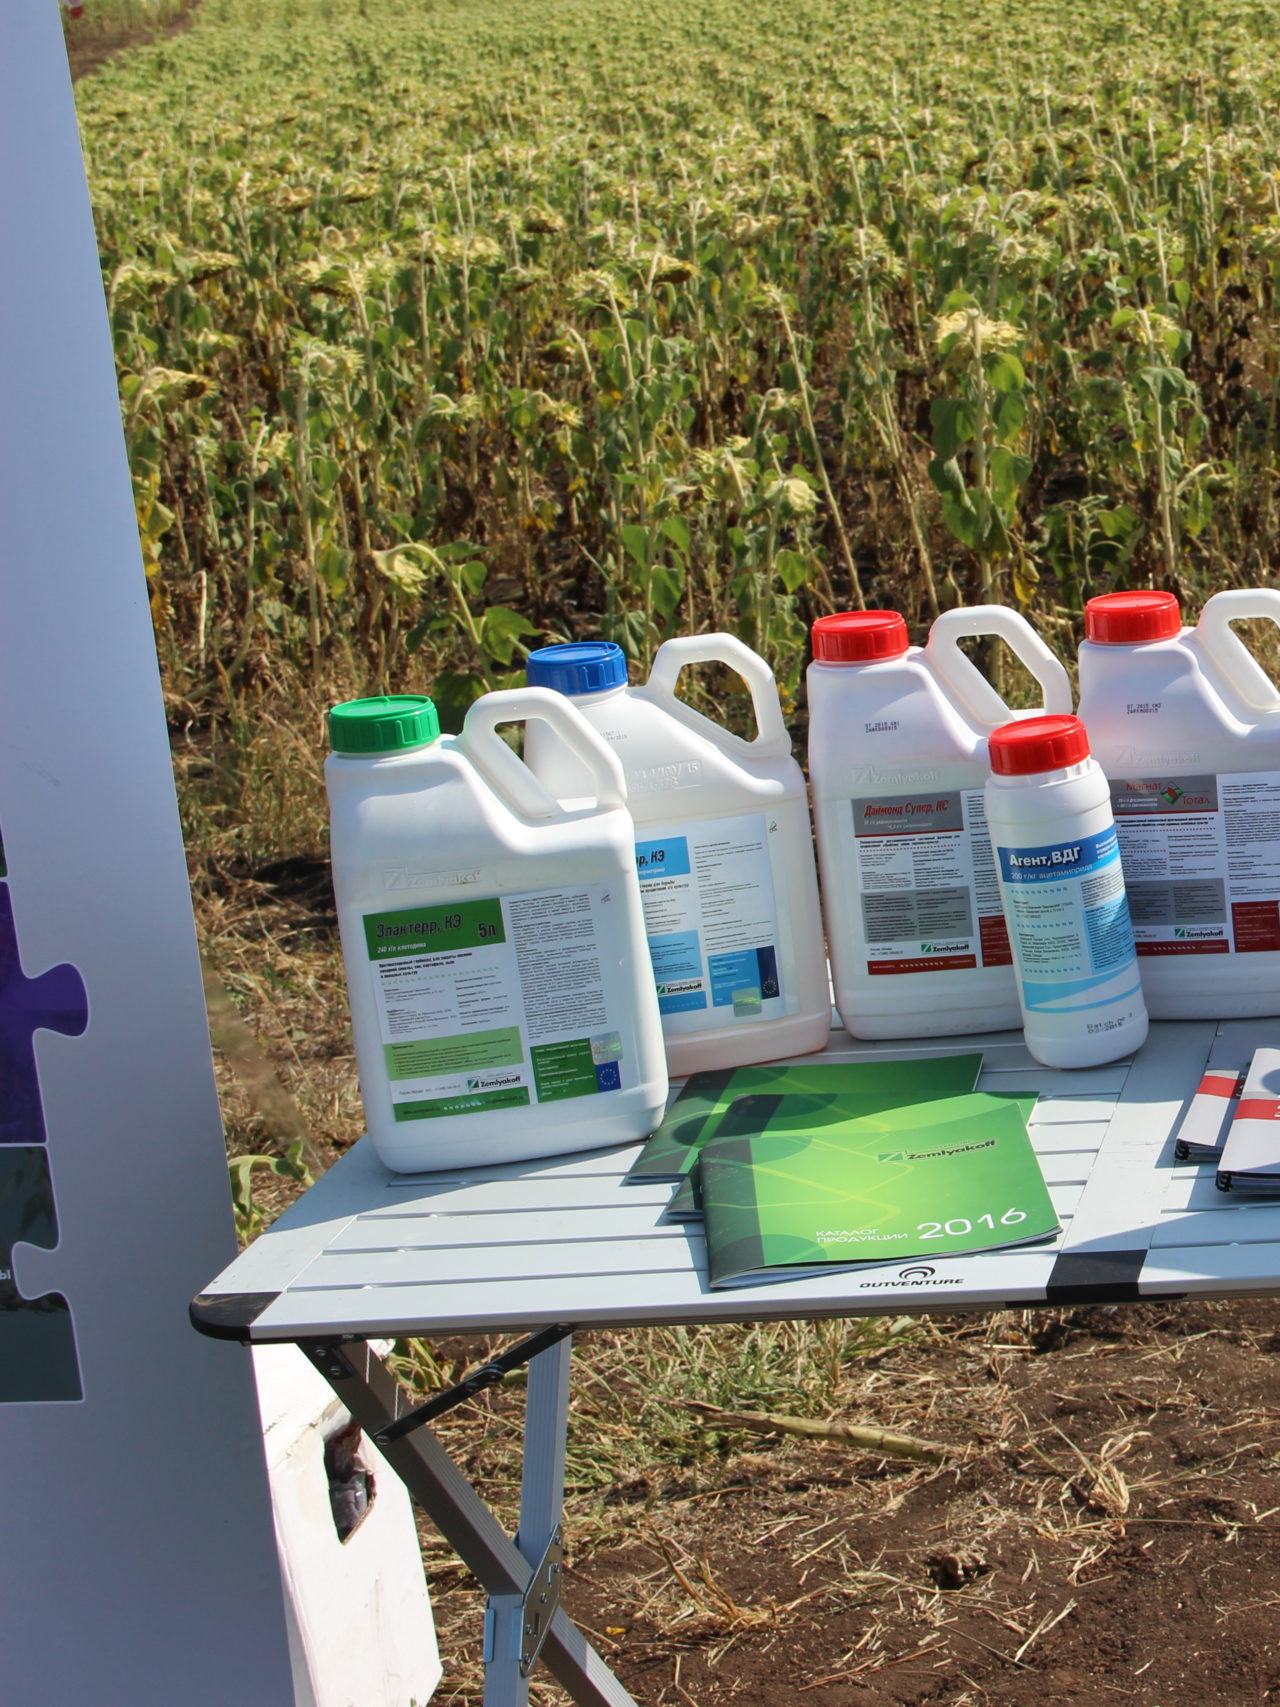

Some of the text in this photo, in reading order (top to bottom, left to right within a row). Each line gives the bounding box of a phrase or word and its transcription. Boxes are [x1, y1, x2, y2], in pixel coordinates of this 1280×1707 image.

[864, 805, 903, 818] Даймонд
[651, 849, 665, 864] КЭ
[376, 913, 462, 938] Злактерр, КЭ
[478, 922, 497, 938] 5л
[1187, 930, 1224, 938] Zemlyakoff
[932, 943, 970, 953] Zemlyakoff
[666, 983, 702, 993] Zemlyakoff
[480, 1076, 521, 1088] Zemlyakoff
[907, 1139, 996, 1160] Zemlyakoff
[916, 1207, 1027, 1239] 2016
[816, 1228, 880, 1236] КАТАЛОГ
[817, 1233, 909, 1243] ПРОДУКЦИИ
[859, 1278, 965, 1288] OUTVENTURE
